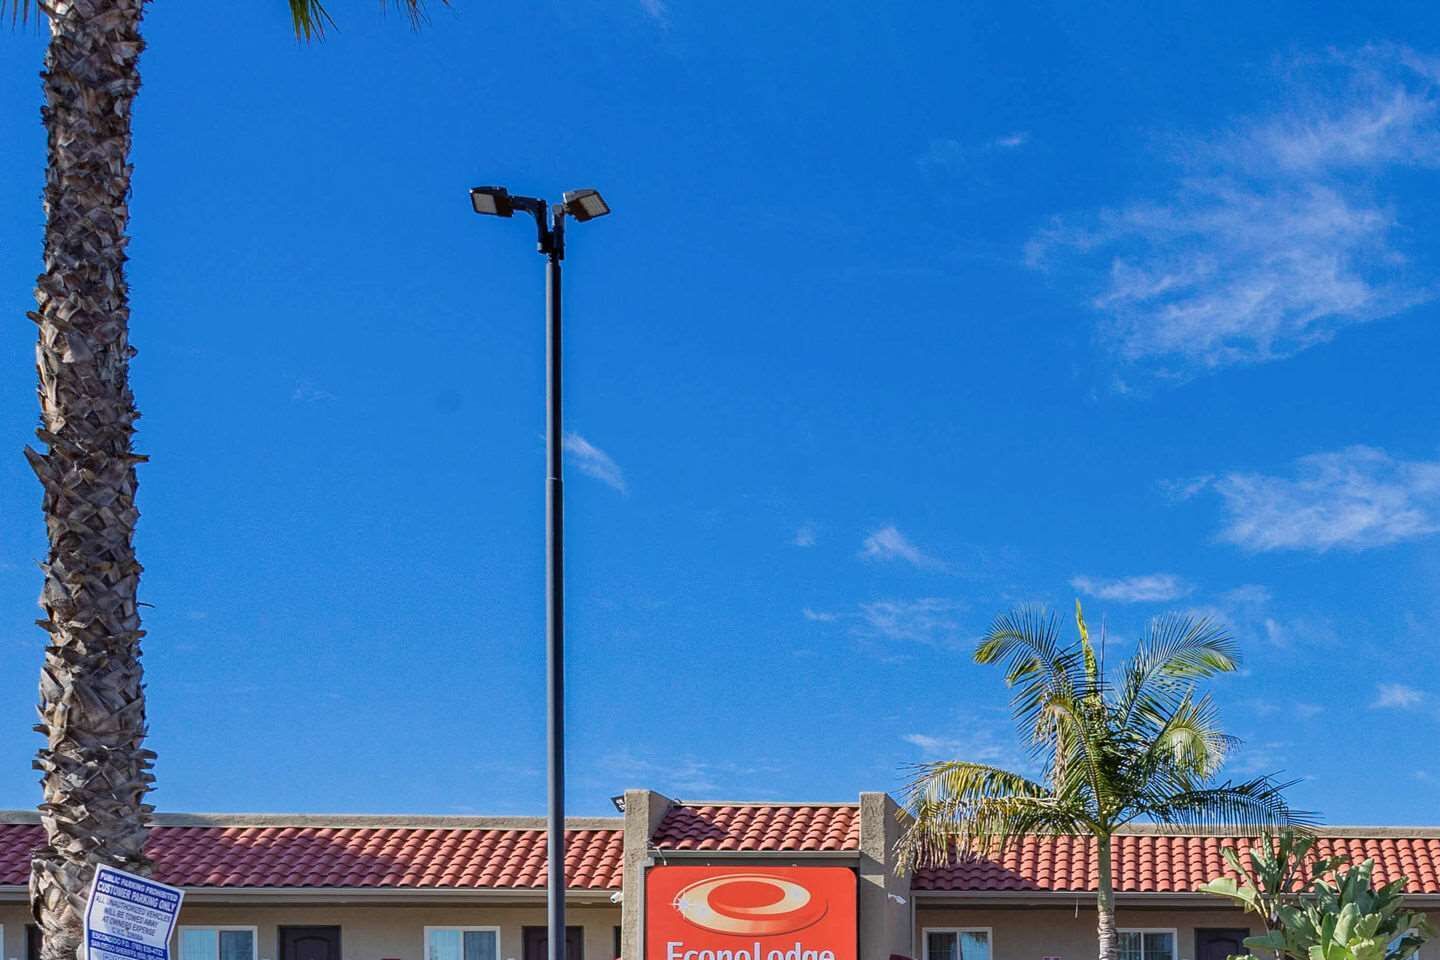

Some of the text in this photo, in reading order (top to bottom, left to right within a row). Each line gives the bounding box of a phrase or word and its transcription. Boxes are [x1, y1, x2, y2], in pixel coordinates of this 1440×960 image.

[98, 882, 176, 912] CUSTOMER PARKING ONLY
[100, 873, 178, 902] PUBLIC PARKING PROHIBITED
[125, 914, 143, 923] TOWED
[133, 925, 155, 936] EXPENSE
